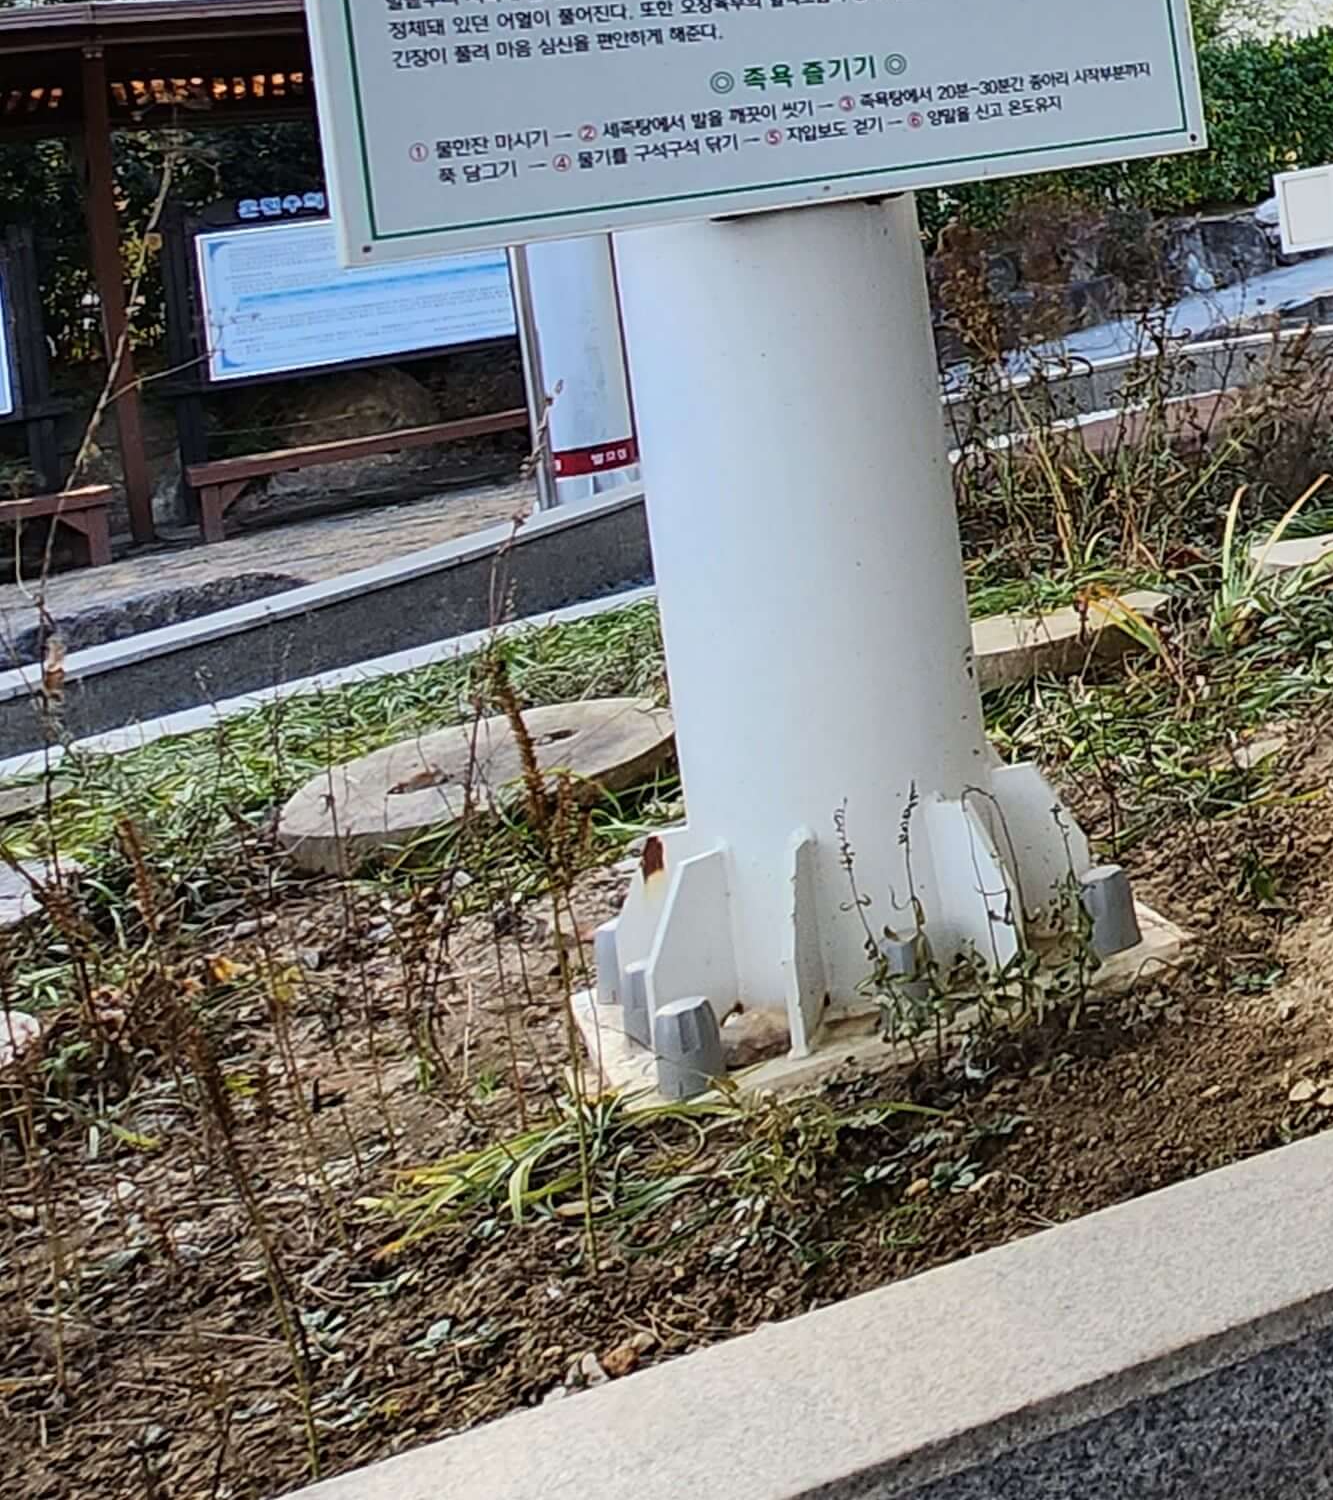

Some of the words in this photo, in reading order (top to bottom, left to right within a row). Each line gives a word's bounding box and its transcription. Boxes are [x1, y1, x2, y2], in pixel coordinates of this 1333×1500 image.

[451, 13, 490, 34] 있던
[495, 8, 552, 31] 어혈이
[639, 0, 674, 18] 또한
[391, 46, 448, 70] 긴장이
[494, 38, 532, 59] 마음
[537, 33, 590, 56] 심신을
[595, 27, 664, 51] 편안하게
[668, 22, 724, 43] 해준다.
[742, 63, 794, 92] 족욕
[801, 54, 877, 87] 즐기기
[434, 135, 490, 160] 물한잔
[493, 128, 549, 152] 마시기
[689, 108, 723, 130] 발을
[780, 98, 814, 120] 씻기
[1028, 70, 1070, 92] 종아리
[461, 159, 518, 184] 담그기
[576, 146, 628, 170] 물기를
[633, 137, 701, 163] 구석구석
[785, 120, 849, 143] 지압보도
[852, 115, 884, 136] 걷기
[974, 101, 1004, 121] 신고
[1007, 94, 1062, 117] 온도유지
